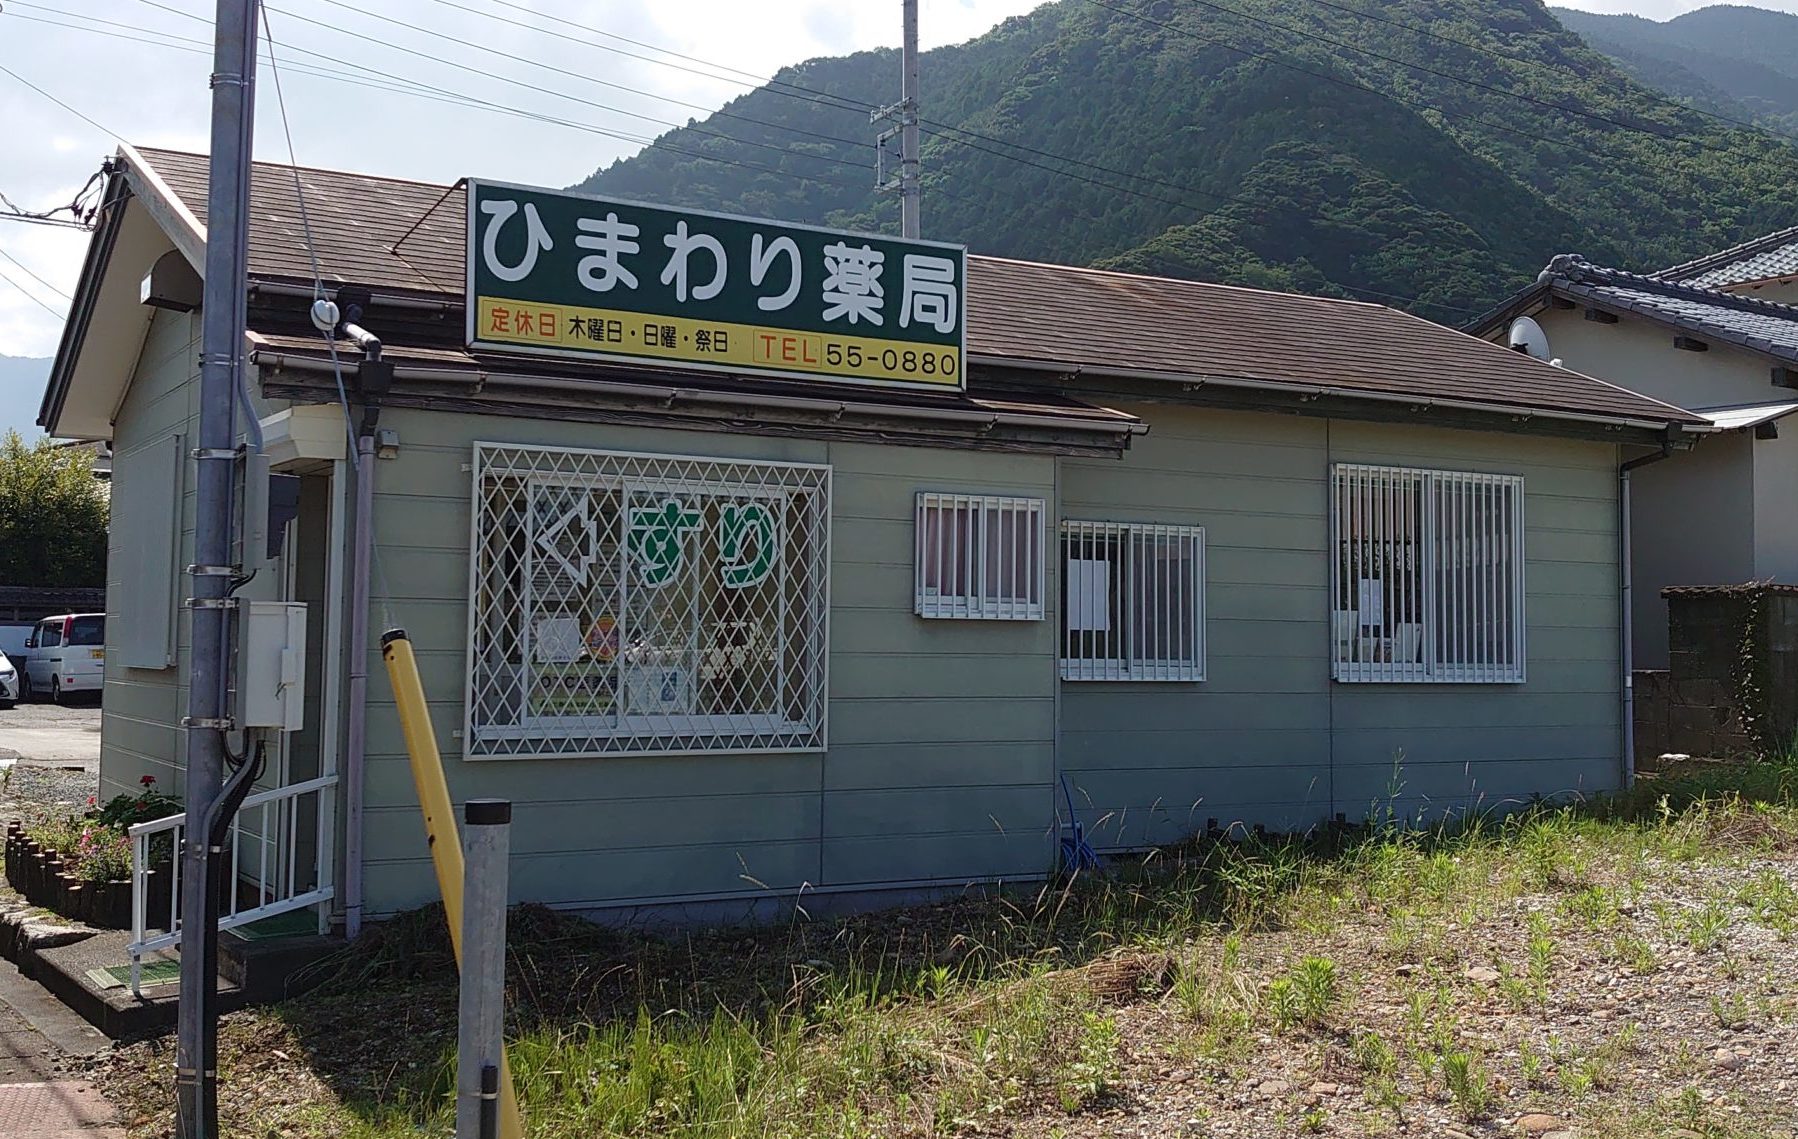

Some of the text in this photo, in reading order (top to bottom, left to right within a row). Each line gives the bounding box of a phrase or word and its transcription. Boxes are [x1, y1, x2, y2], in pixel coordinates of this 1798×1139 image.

[480, 200, 957, 333] ひまわり薬局
[491, 307, 728, 353] 定休日 木曜日・日曜・祭日
[760, 335, 956, 376] TEL 55-0880
[536, 494, 776, 589] くすり
